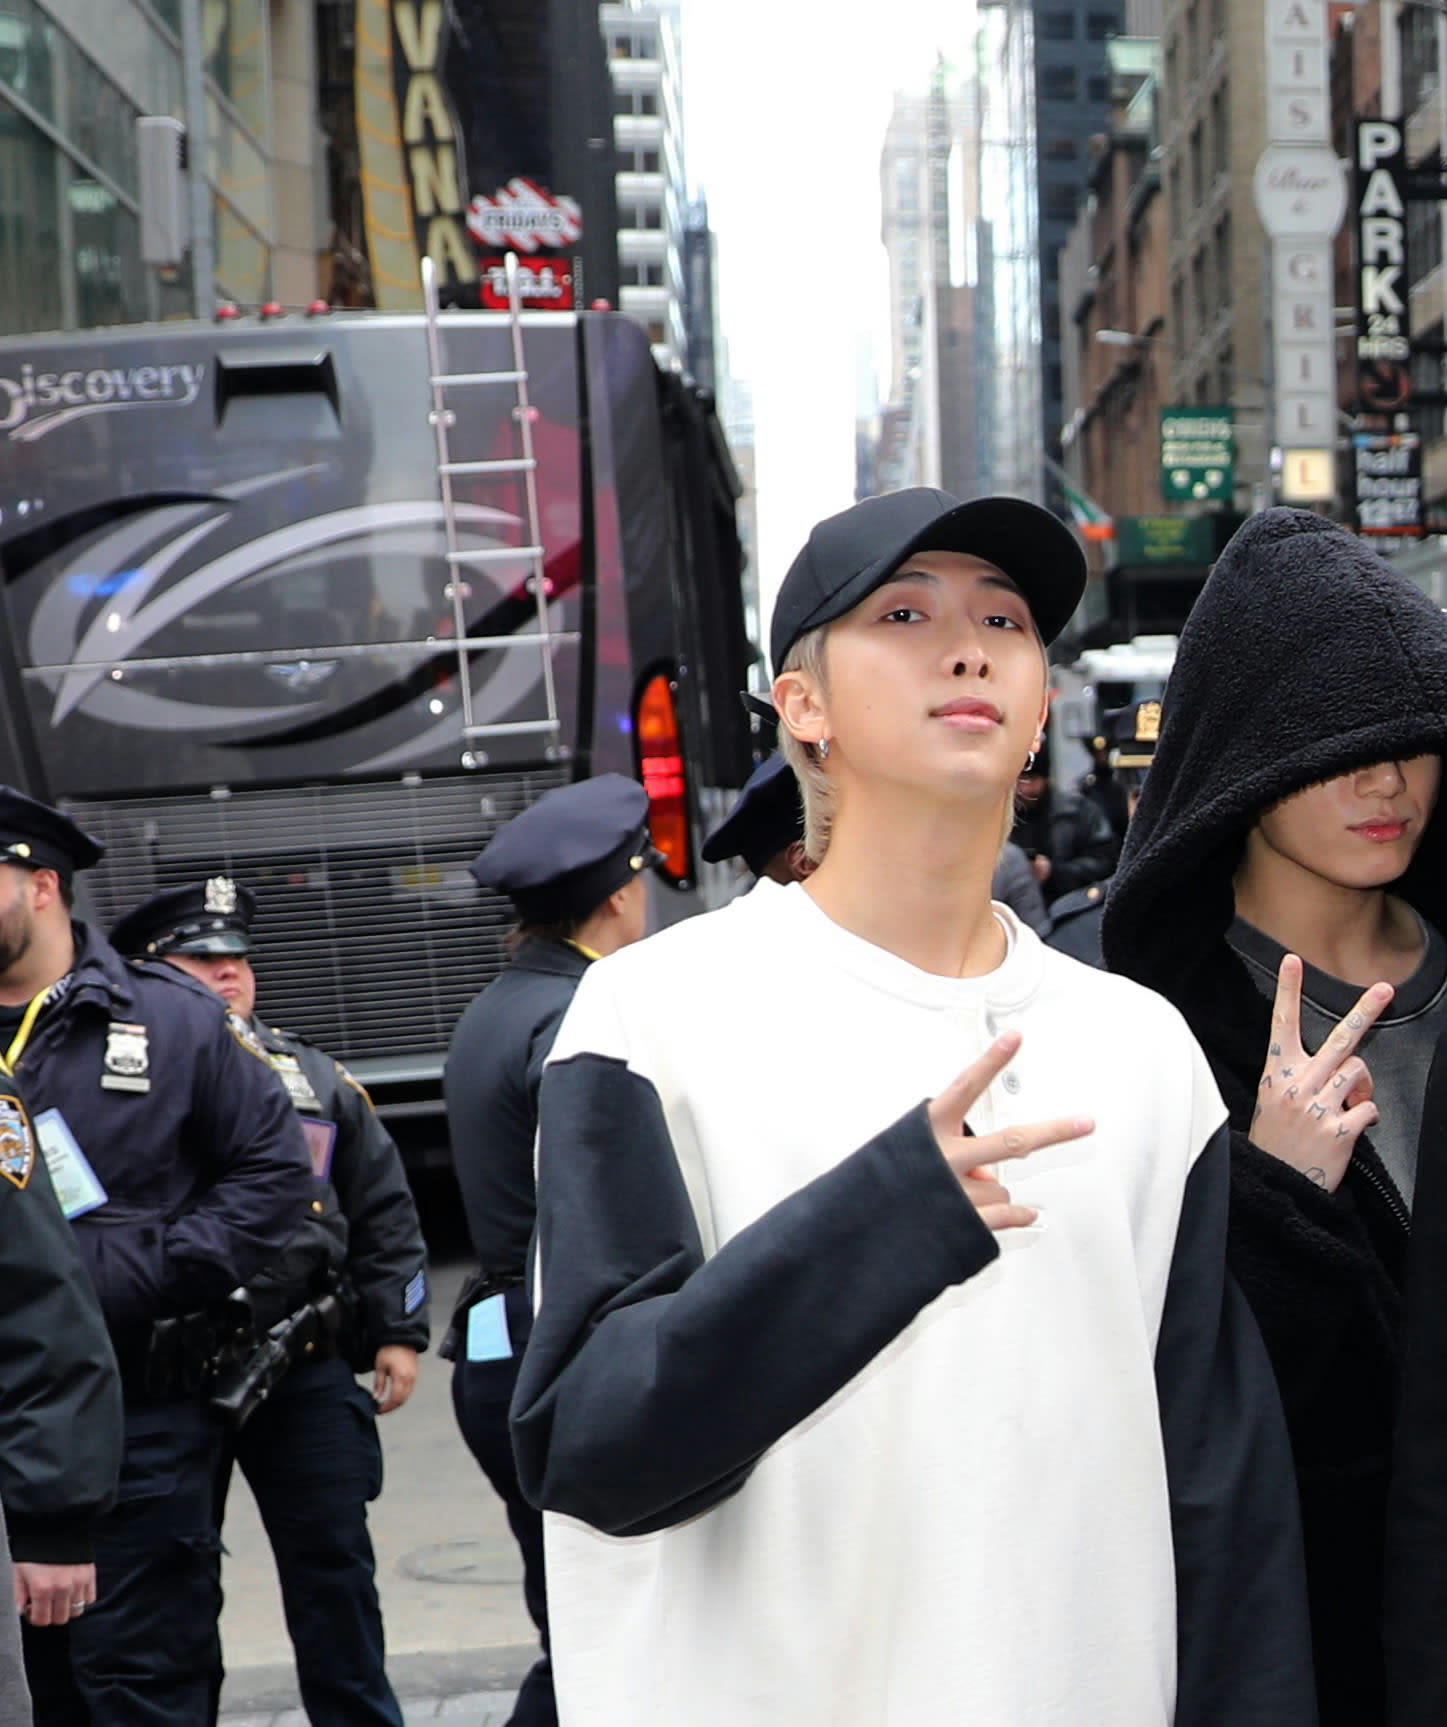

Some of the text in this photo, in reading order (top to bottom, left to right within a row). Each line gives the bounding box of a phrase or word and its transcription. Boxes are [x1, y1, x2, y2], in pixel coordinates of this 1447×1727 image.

[1358, 121, 1404, 314] PARK
[1367, 313, 1400, 335] 24
[1358, 336, 1409, 360] HRS
